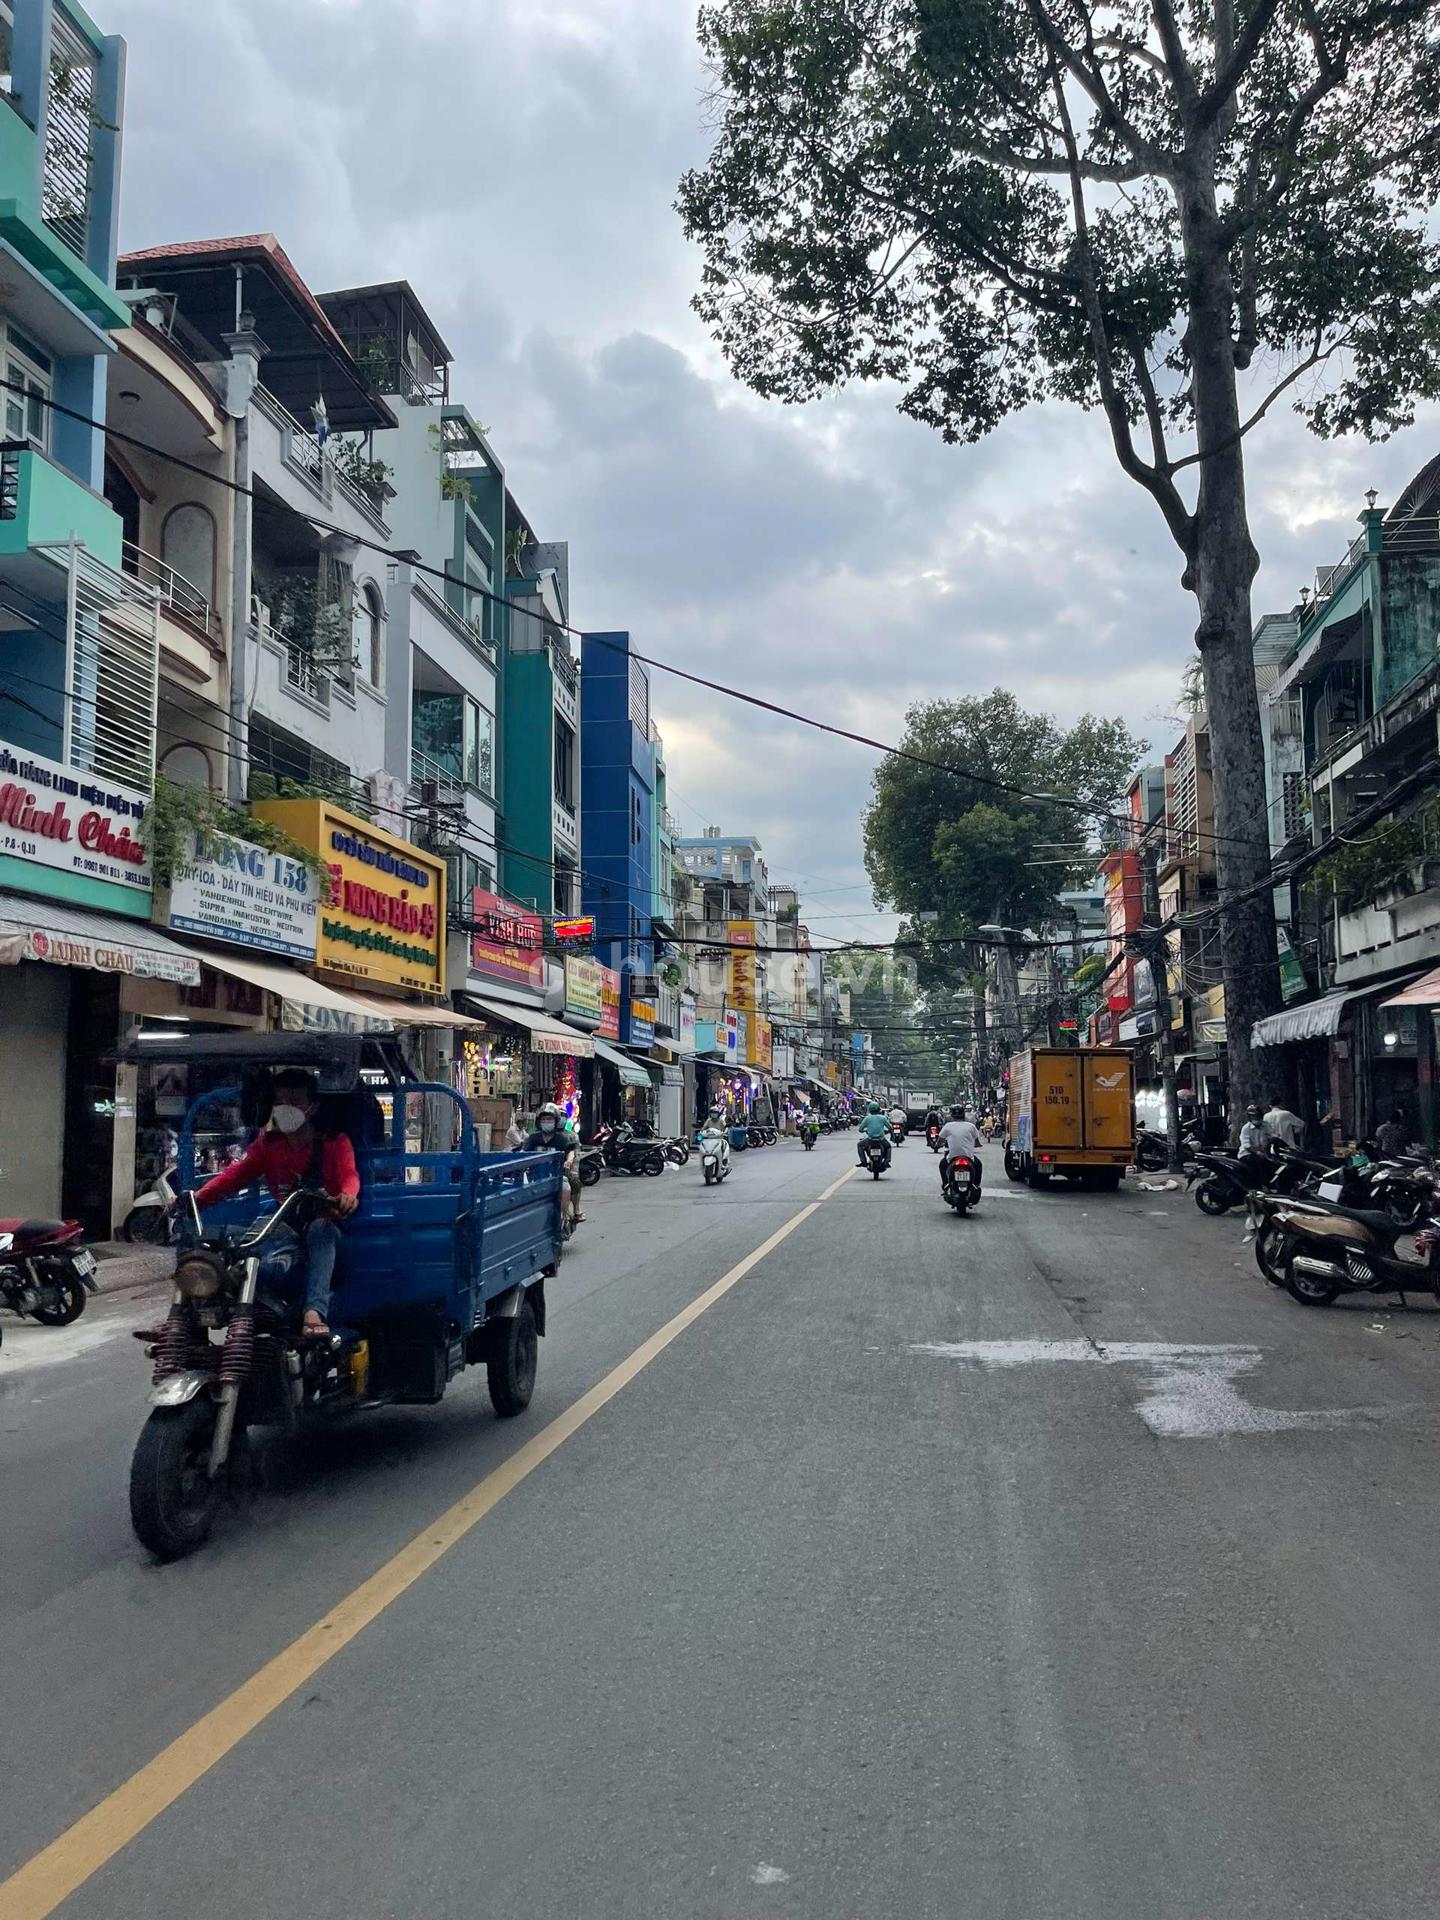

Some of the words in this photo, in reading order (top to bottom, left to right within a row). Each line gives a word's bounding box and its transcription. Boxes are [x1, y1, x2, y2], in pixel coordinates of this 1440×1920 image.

[0, 783, 73, 843] Minh
[272, 857, 309, 896] 158
[199, 900, 226, 914] SUPRA
[51, 940, 92, 964] MINH
